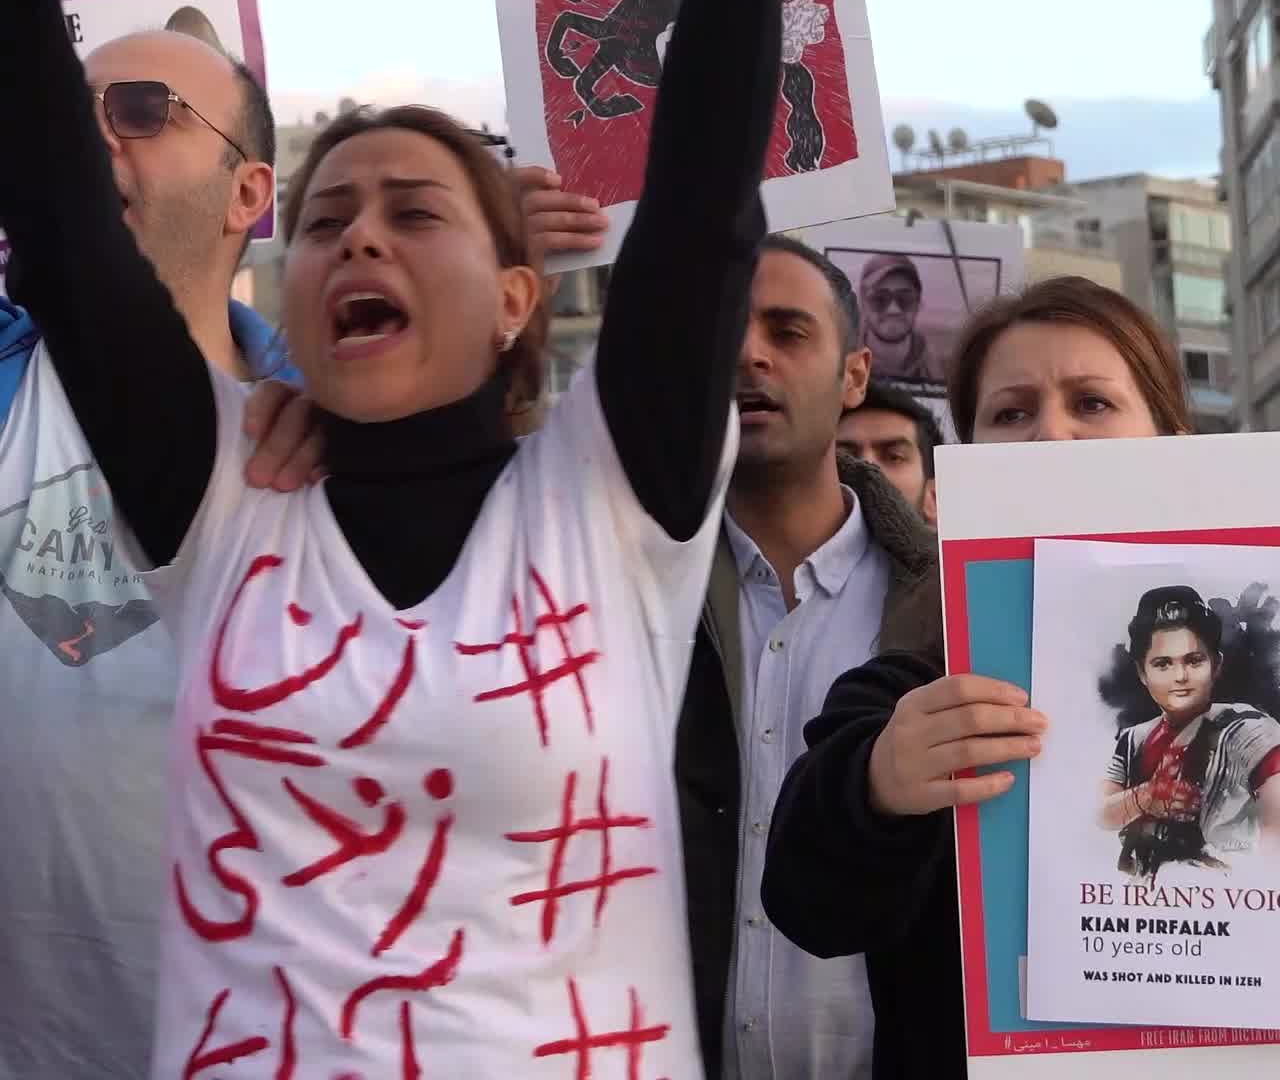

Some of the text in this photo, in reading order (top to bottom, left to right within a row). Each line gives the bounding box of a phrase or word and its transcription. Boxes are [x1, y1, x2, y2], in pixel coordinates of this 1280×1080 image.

[26, 563, 104, 585] NATIONAL
[1080, 883, 1114, 906] BE
[1081, 916, 1231, 937] KIAN PIRFALAK
[1082, 936, 1202, 958] 10 years old
[1083, 970, 1262, 988] WAS SHOT AND KILLED IN IZEH
[1141, 1030, 1165, 1047] FREE
[1168, 1029, 1194, 1046] IRAN
[1198, 1028, 1229, 1044] FROM
